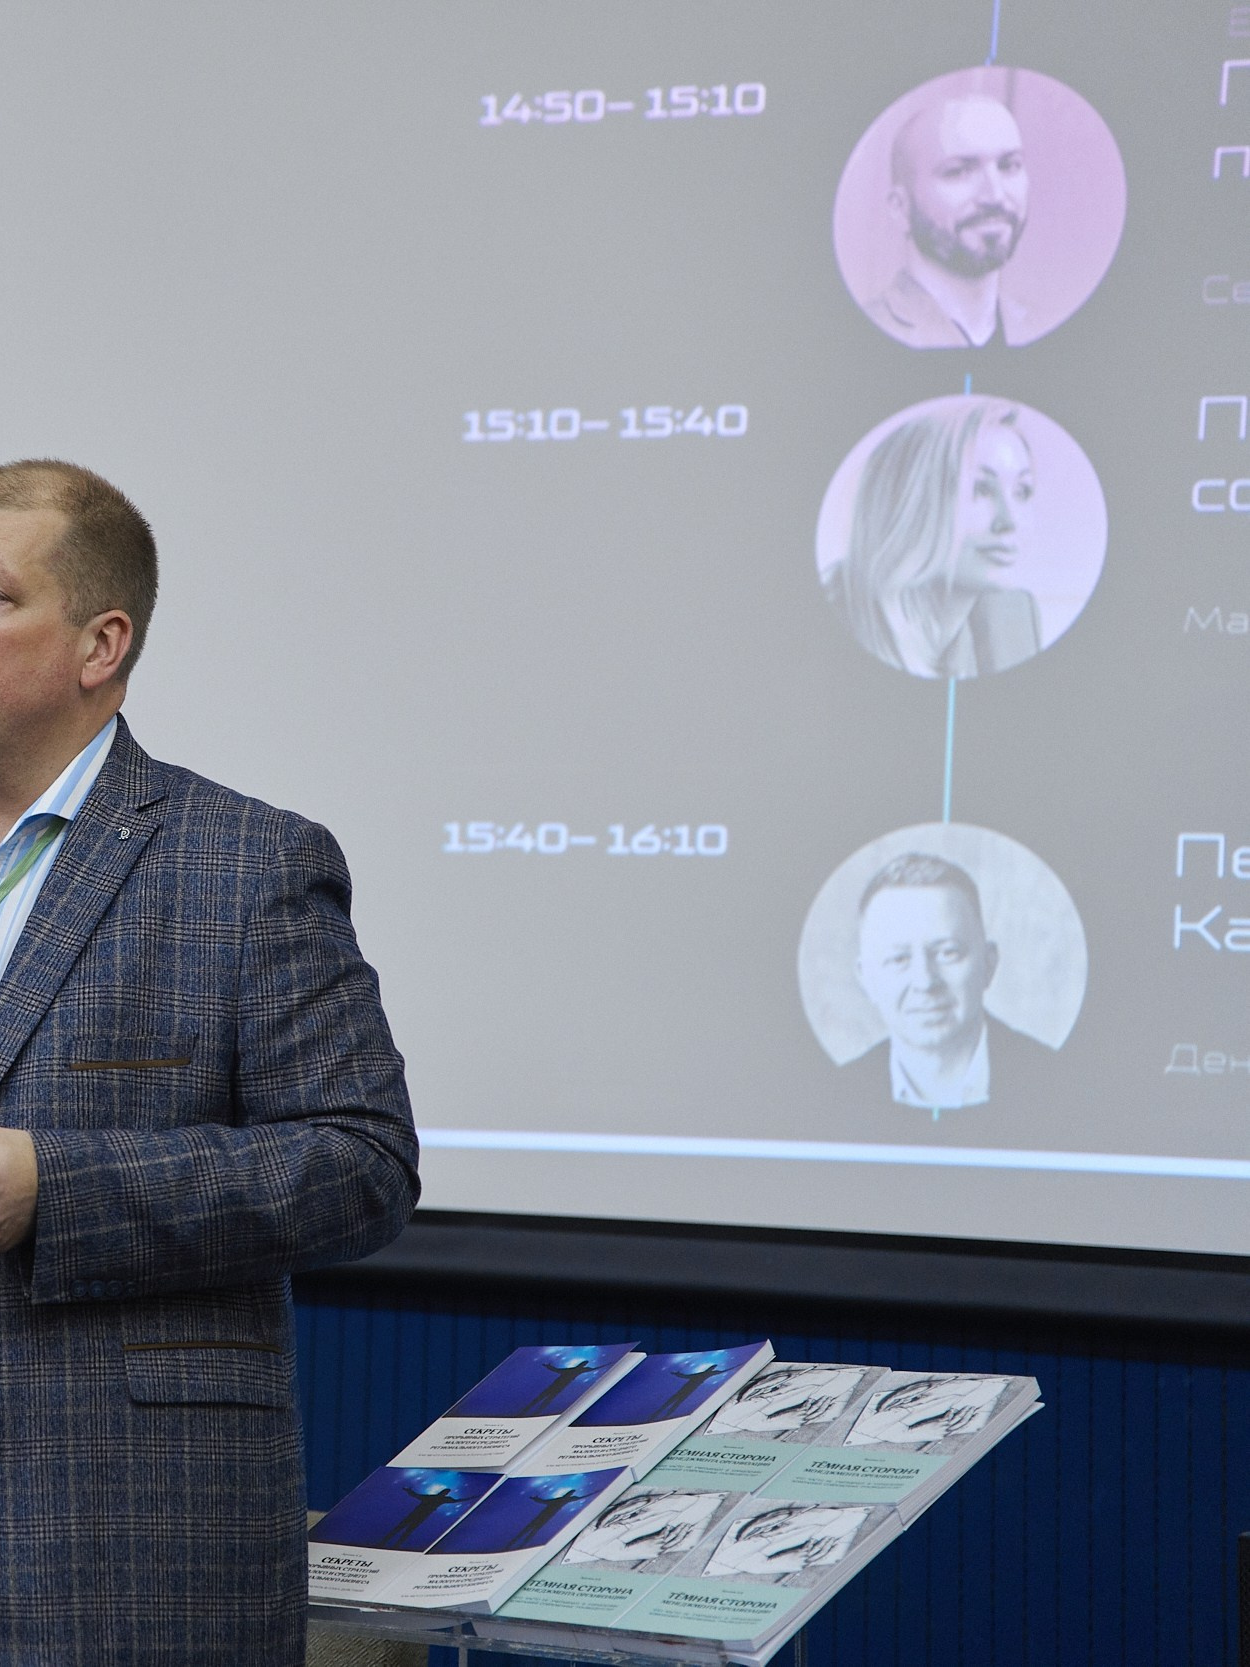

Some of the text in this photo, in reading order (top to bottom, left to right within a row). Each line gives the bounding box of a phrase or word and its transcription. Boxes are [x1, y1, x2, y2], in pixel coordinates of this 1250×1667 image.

[643, 81, 767, 119] 15:10
[618, 403, 749, 440] 15:40
[606, 822, 729, 857] 16:10
[592, 1434, 644, 1443] СЕКРЕТЫ
[672, 1448, 777, 1461] ТЁМНАЯ СТОРОНА
[811, 1460, 920, 1474] ТЁМНАЯ СТОРОНА
[321, 1557, 373, 1568] СЕКРЕТЫ
[448, 1564, 499, 1573] СЕКРЕТЫ
[529, 1580, 634, 1595] ТЁМНАЯ СТОРОНА
[669, 1592, 778, 1609] ТЁМНАЯ СТОРОНА
